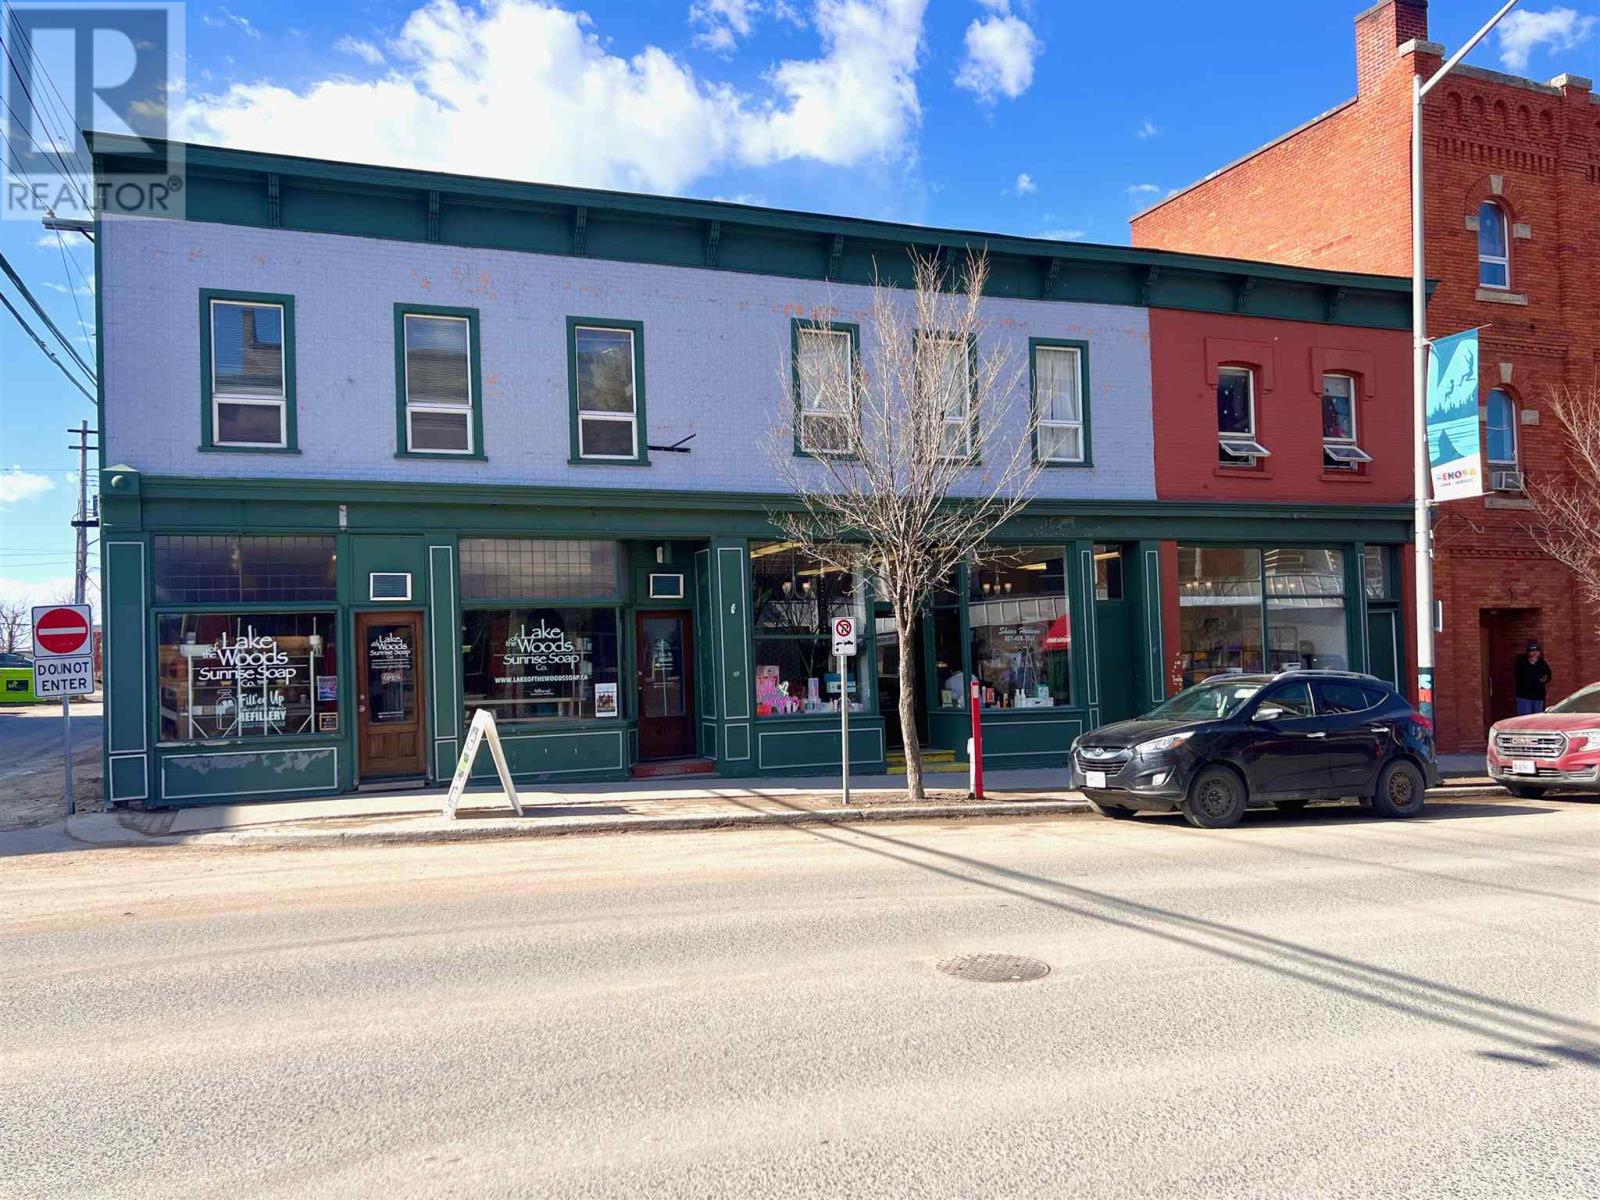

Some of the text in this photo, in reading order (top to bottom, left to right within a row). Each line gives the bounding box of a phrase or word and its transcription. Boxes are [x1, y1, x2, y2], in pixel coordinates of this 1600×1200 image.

[222, 625, 273, 649] Lake
[521, 618, 561, 639] Lake
[376, 639, 408, 651] Woods
[378, 632, 401, 643] Lake
[517, 632, 573, 653] Woods
[217, 641, 289, 666] Woods
[503, 652, 579, 669] Sunrise Soap
[37, 661, 89, 676] DO NOT
[198, 665, 297, 685] Sunrise Soap
[42, 677, 87, 691] ENTER
[240, 679, 256, 687] Co.
[269, 689, 285, 706] Up
[238, 710, 287, 722] REFILLERY
